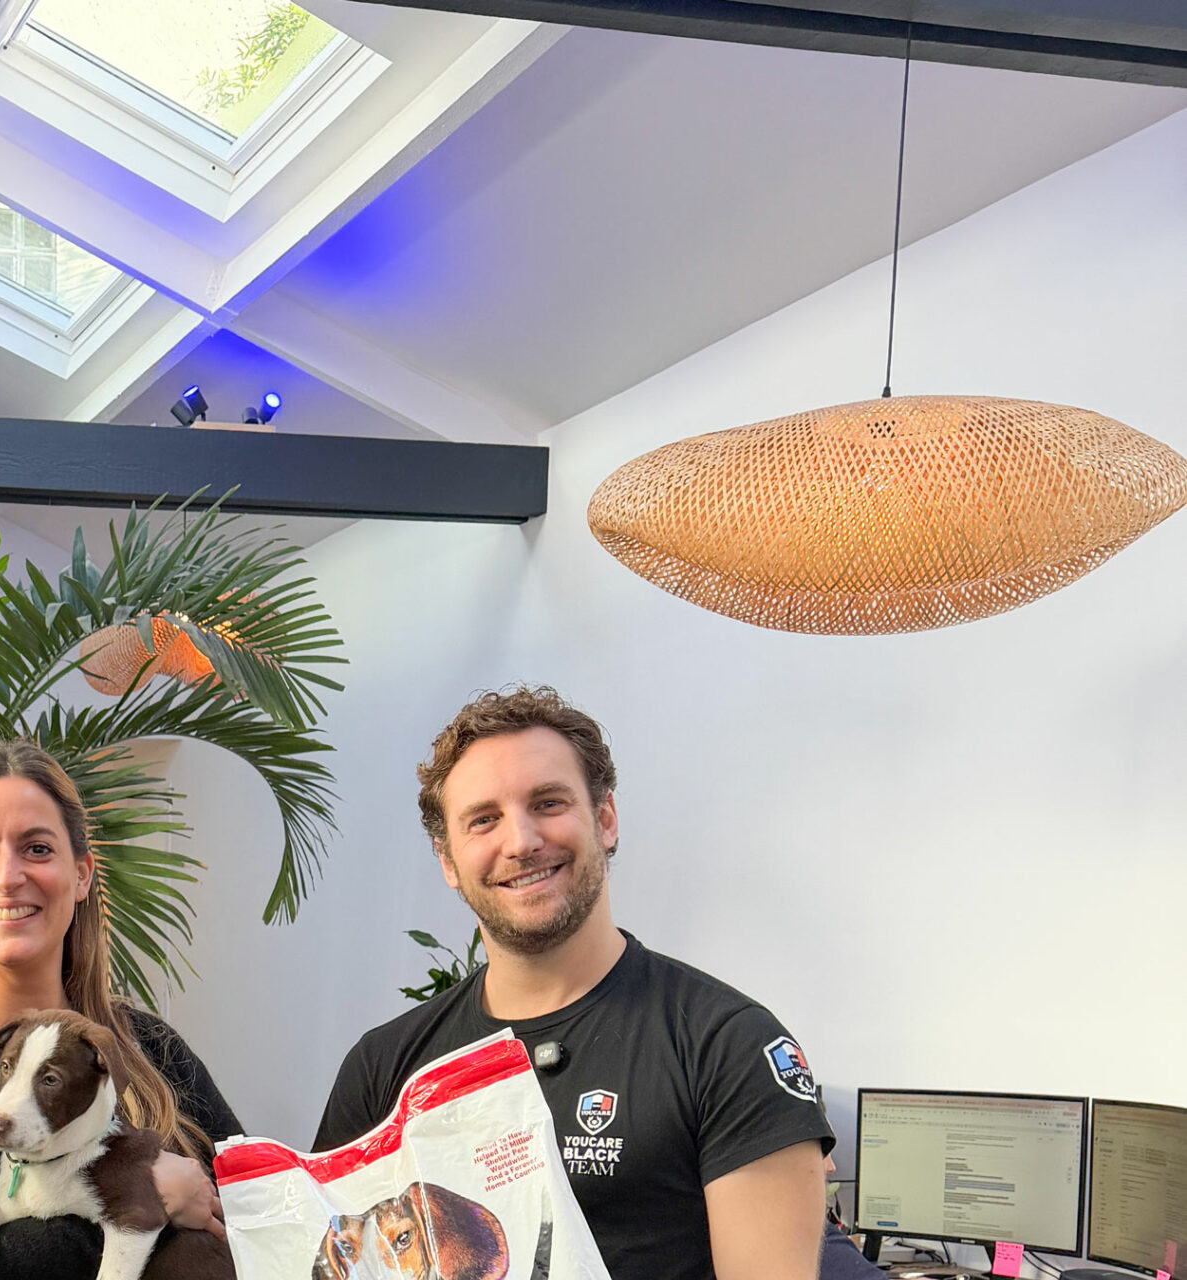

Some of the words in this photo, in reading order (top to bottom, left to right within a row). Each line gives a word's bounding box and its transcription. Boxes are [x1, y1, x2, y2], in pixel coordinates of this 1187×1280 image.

[474, 1148, 499, 1164] Helped
[509, 1134, 534, 1148] Million
[564, 1136, 624, 1149] YOUCARE
[484, 1152, 511, 1168] Shelter
[512, 1146, 529, 1156] Pets
[563, 1147, 621, 1162] BLACK
[490, 1153, 529, 1173] Worldwide
[567, 1160, 614, 1177] TEAM
[485, 1180, 506, 1192] Home
[486, 1172, 503, 1184] Find
